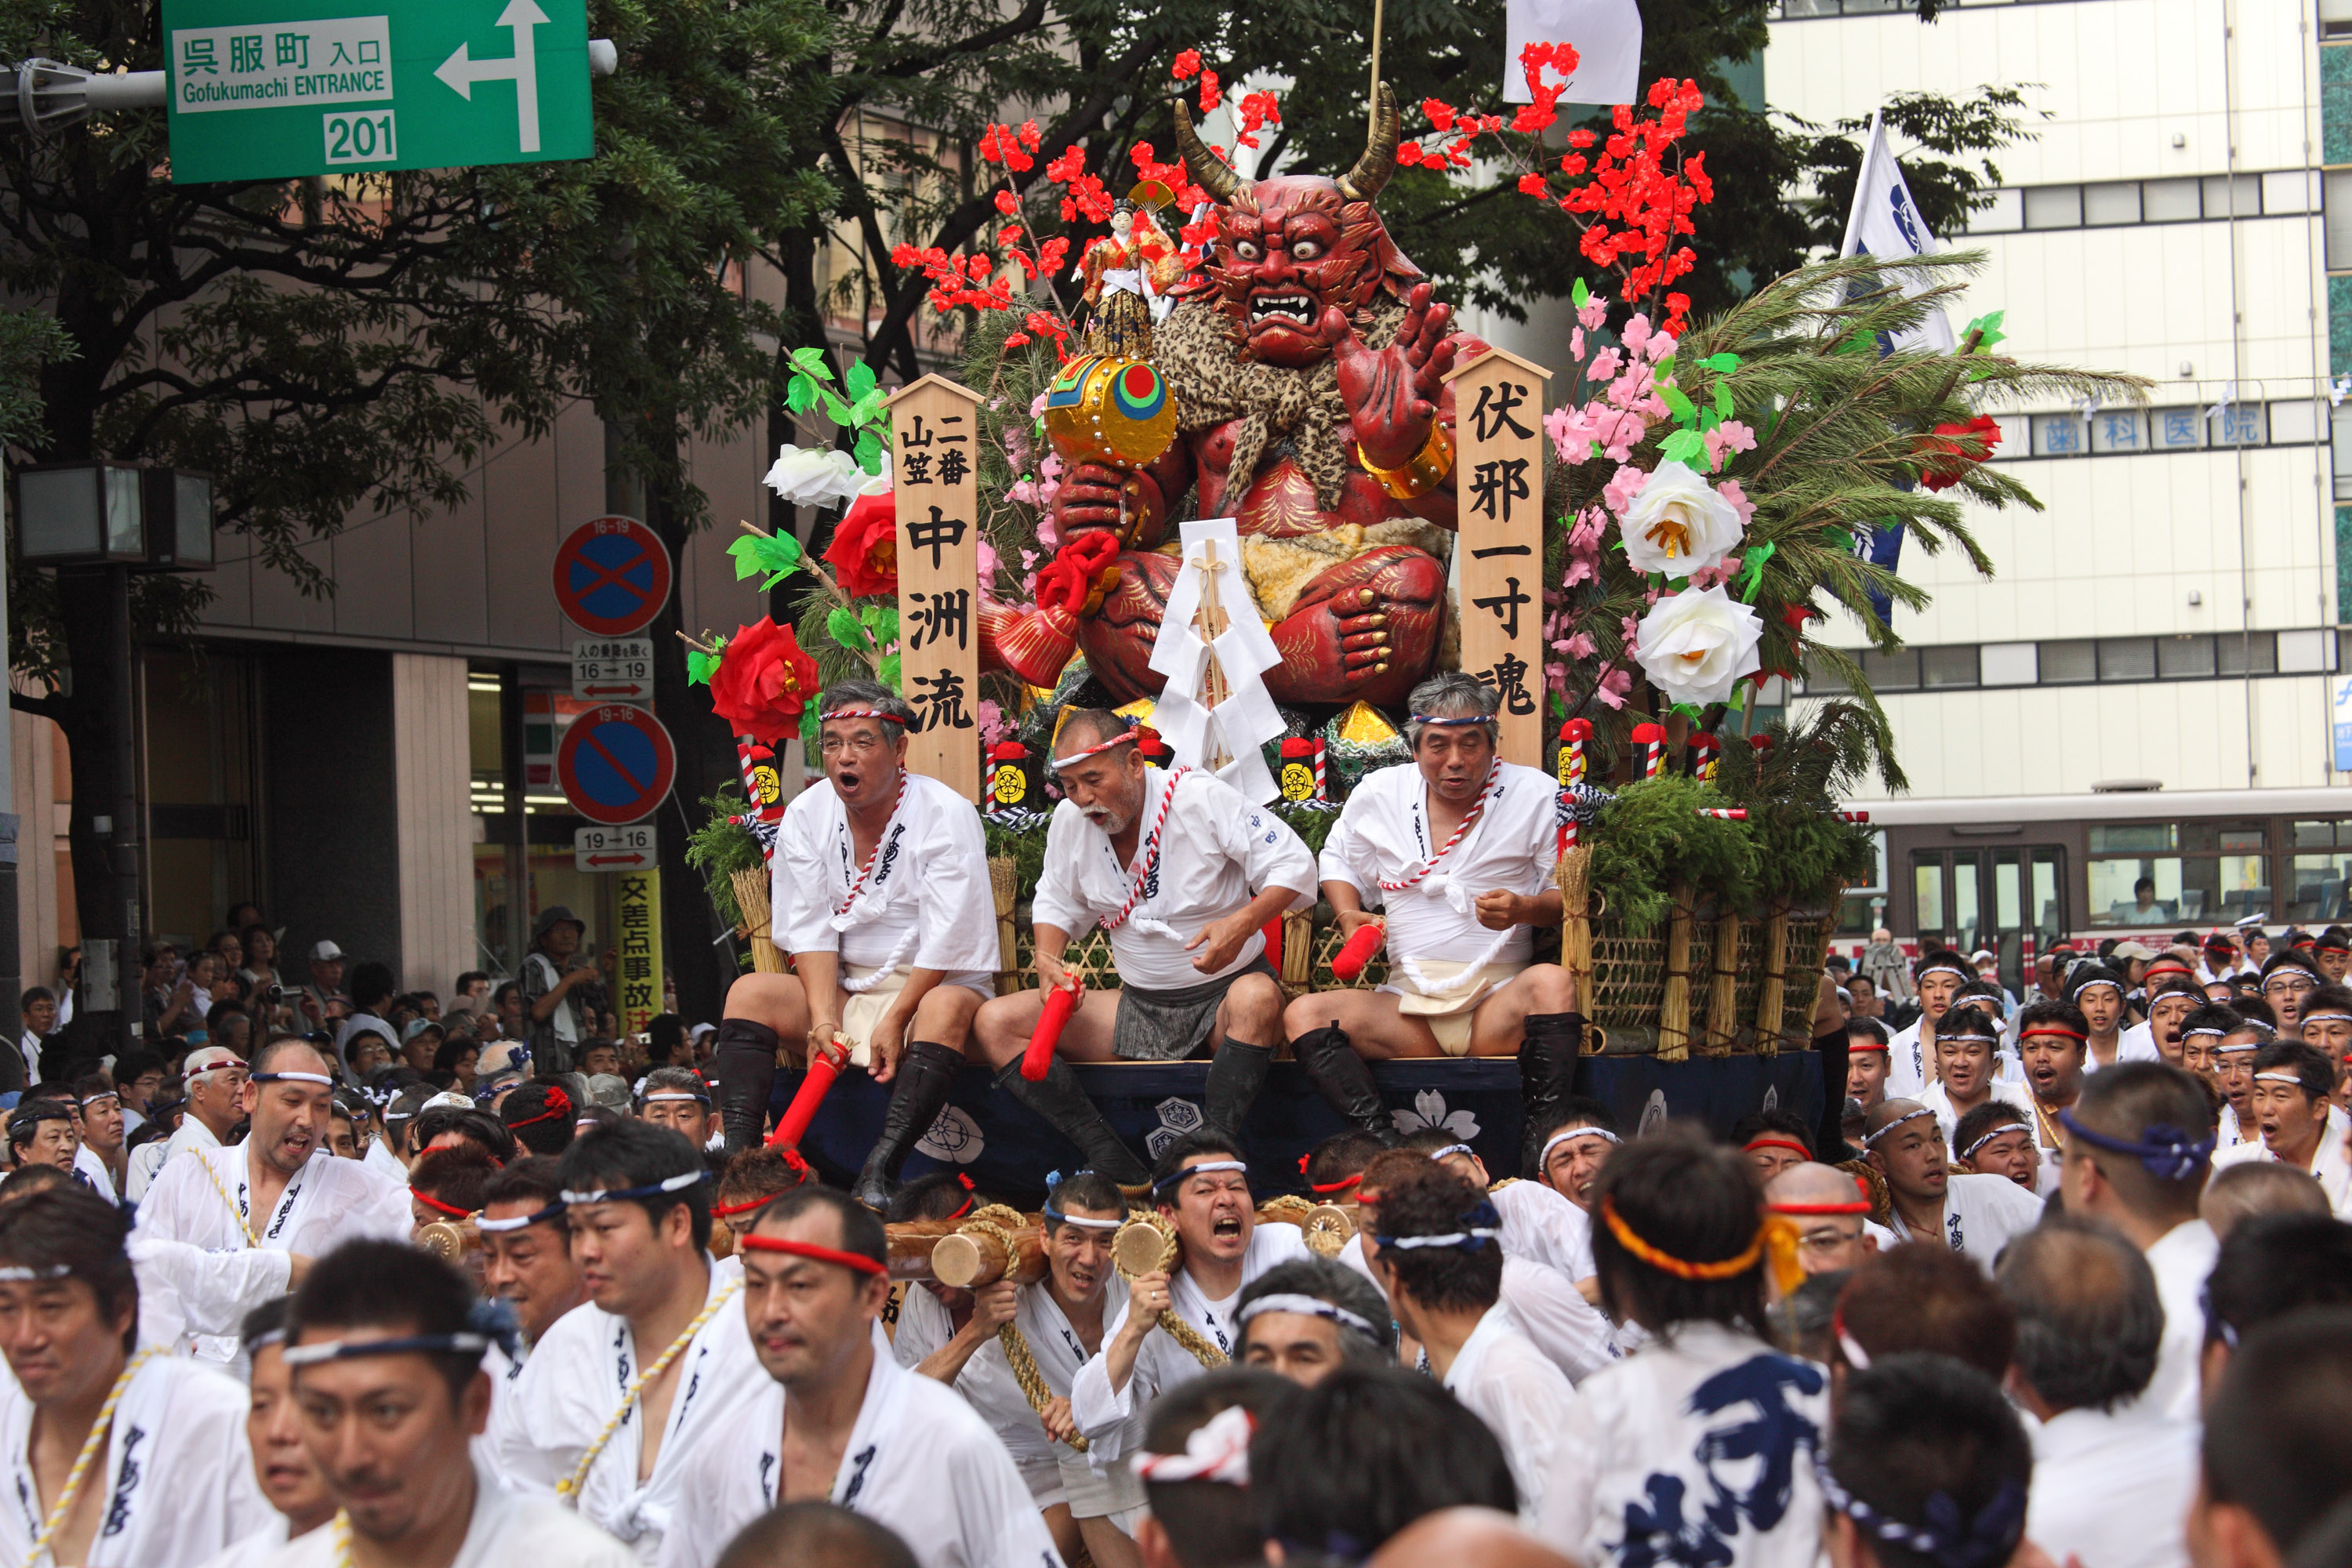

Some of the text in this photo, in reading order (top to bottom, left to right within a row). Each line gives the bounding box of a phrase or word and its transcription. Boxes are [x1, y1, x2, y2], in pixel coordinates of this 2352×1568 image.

[183, 32, 380, 76] 呉服町 入口
[183, 70, 385, 103] Gofukumachi ENTRANCE
[328, 115, 393, 158] 201
[2045, 409, 2259, 452] 歯科医院
[905, 504, 975, 734] 中洲流
